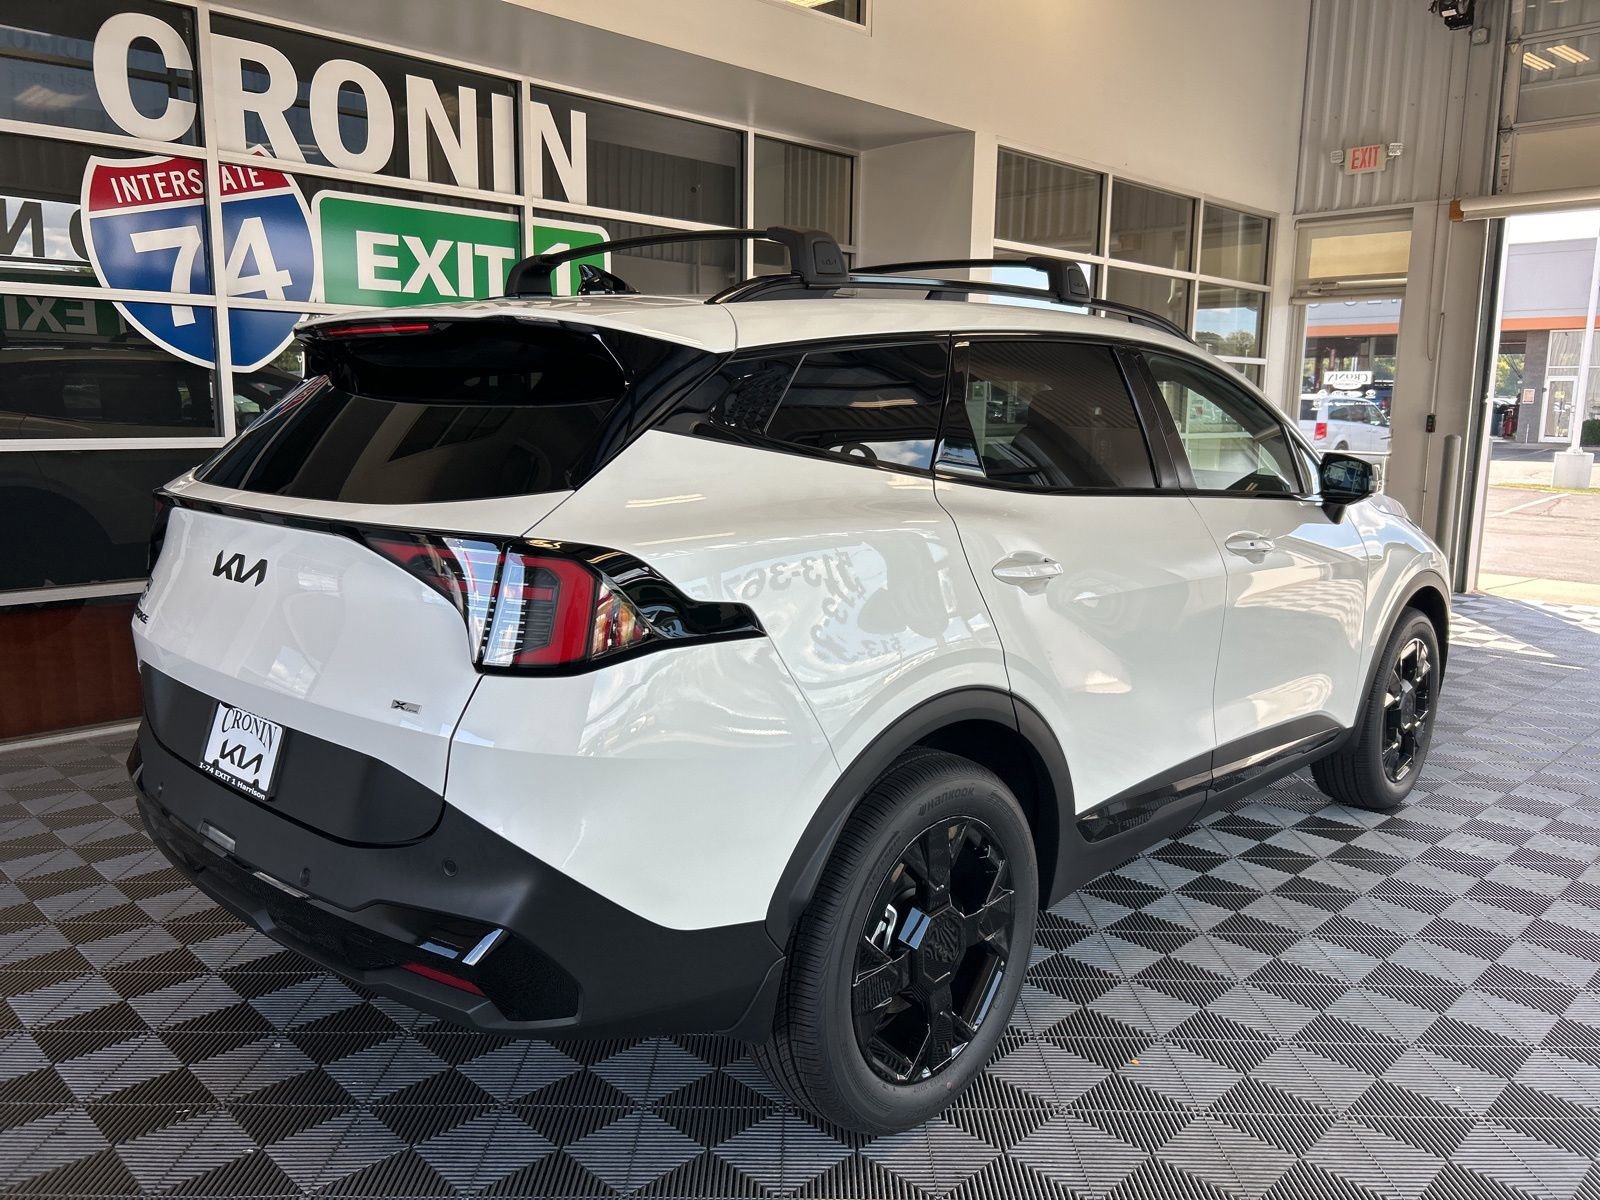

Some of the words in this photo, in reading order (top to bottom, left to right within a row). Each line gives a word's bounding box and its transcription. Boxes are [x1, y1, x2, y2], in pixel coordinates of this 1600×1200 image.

[92, 12, 588, 206] CRONIN
[1351, 146, 1380, 169] EXIT
[110, 167, 265, 204] INTERSATE
[130, 216, 293, 327] 74
[356, 230, 515, 298] EXIT
[212, 550, 268, 587] KIA
[221, 707, 278, 753] CRONIN
[219, 739, 264, 775] KIA
[214, 769, 231, 783] EXIT
[231, 778, 236, 786] 1
[237, 780, 266, 801] Harrison
